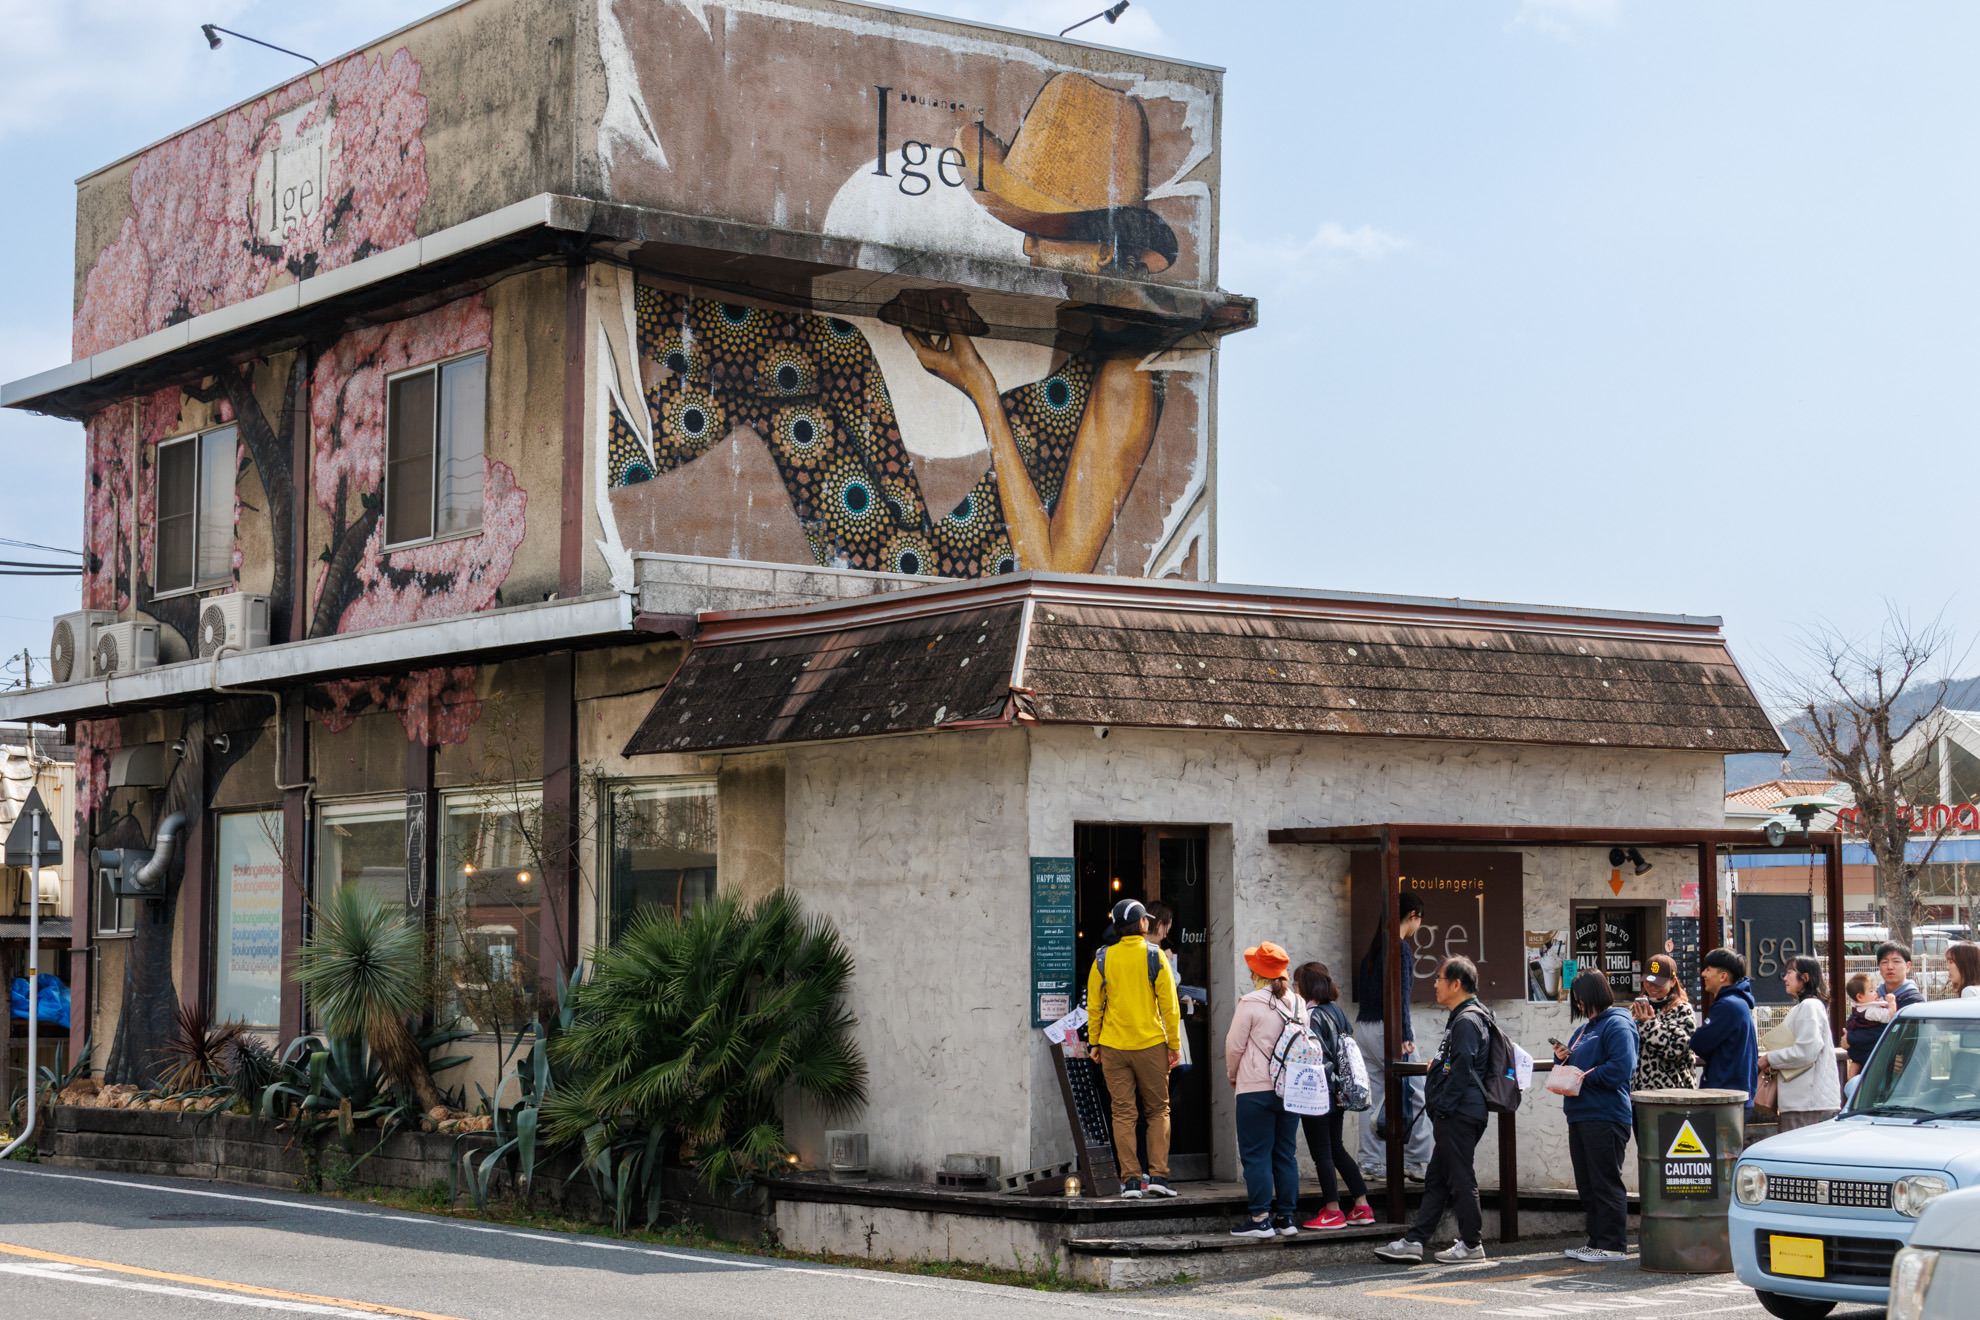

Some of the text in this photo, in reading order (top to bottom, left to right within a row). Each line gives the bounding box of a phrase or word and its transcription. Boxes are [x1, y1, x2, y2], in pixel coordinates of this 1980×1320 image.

[901, 89, 984, 115] boulangerie
[871, 84, 988, 196] Igel
[270, 144, 323, 240] Igel
[1836, 803, 1979, 835] mruna
[1036, 874, 1071, 883] HAPPY HOUR
[1411, 877, 1484, 892] boulangerie
[1399, 876, 1488, 979] gel
[1619, 929, 1630, 942] TO
[1605, 955, 1630, 970] THRU
[1740, 919, 1807, 981] Igel
[1665, 1162, 1712, 1176] CAUTION
